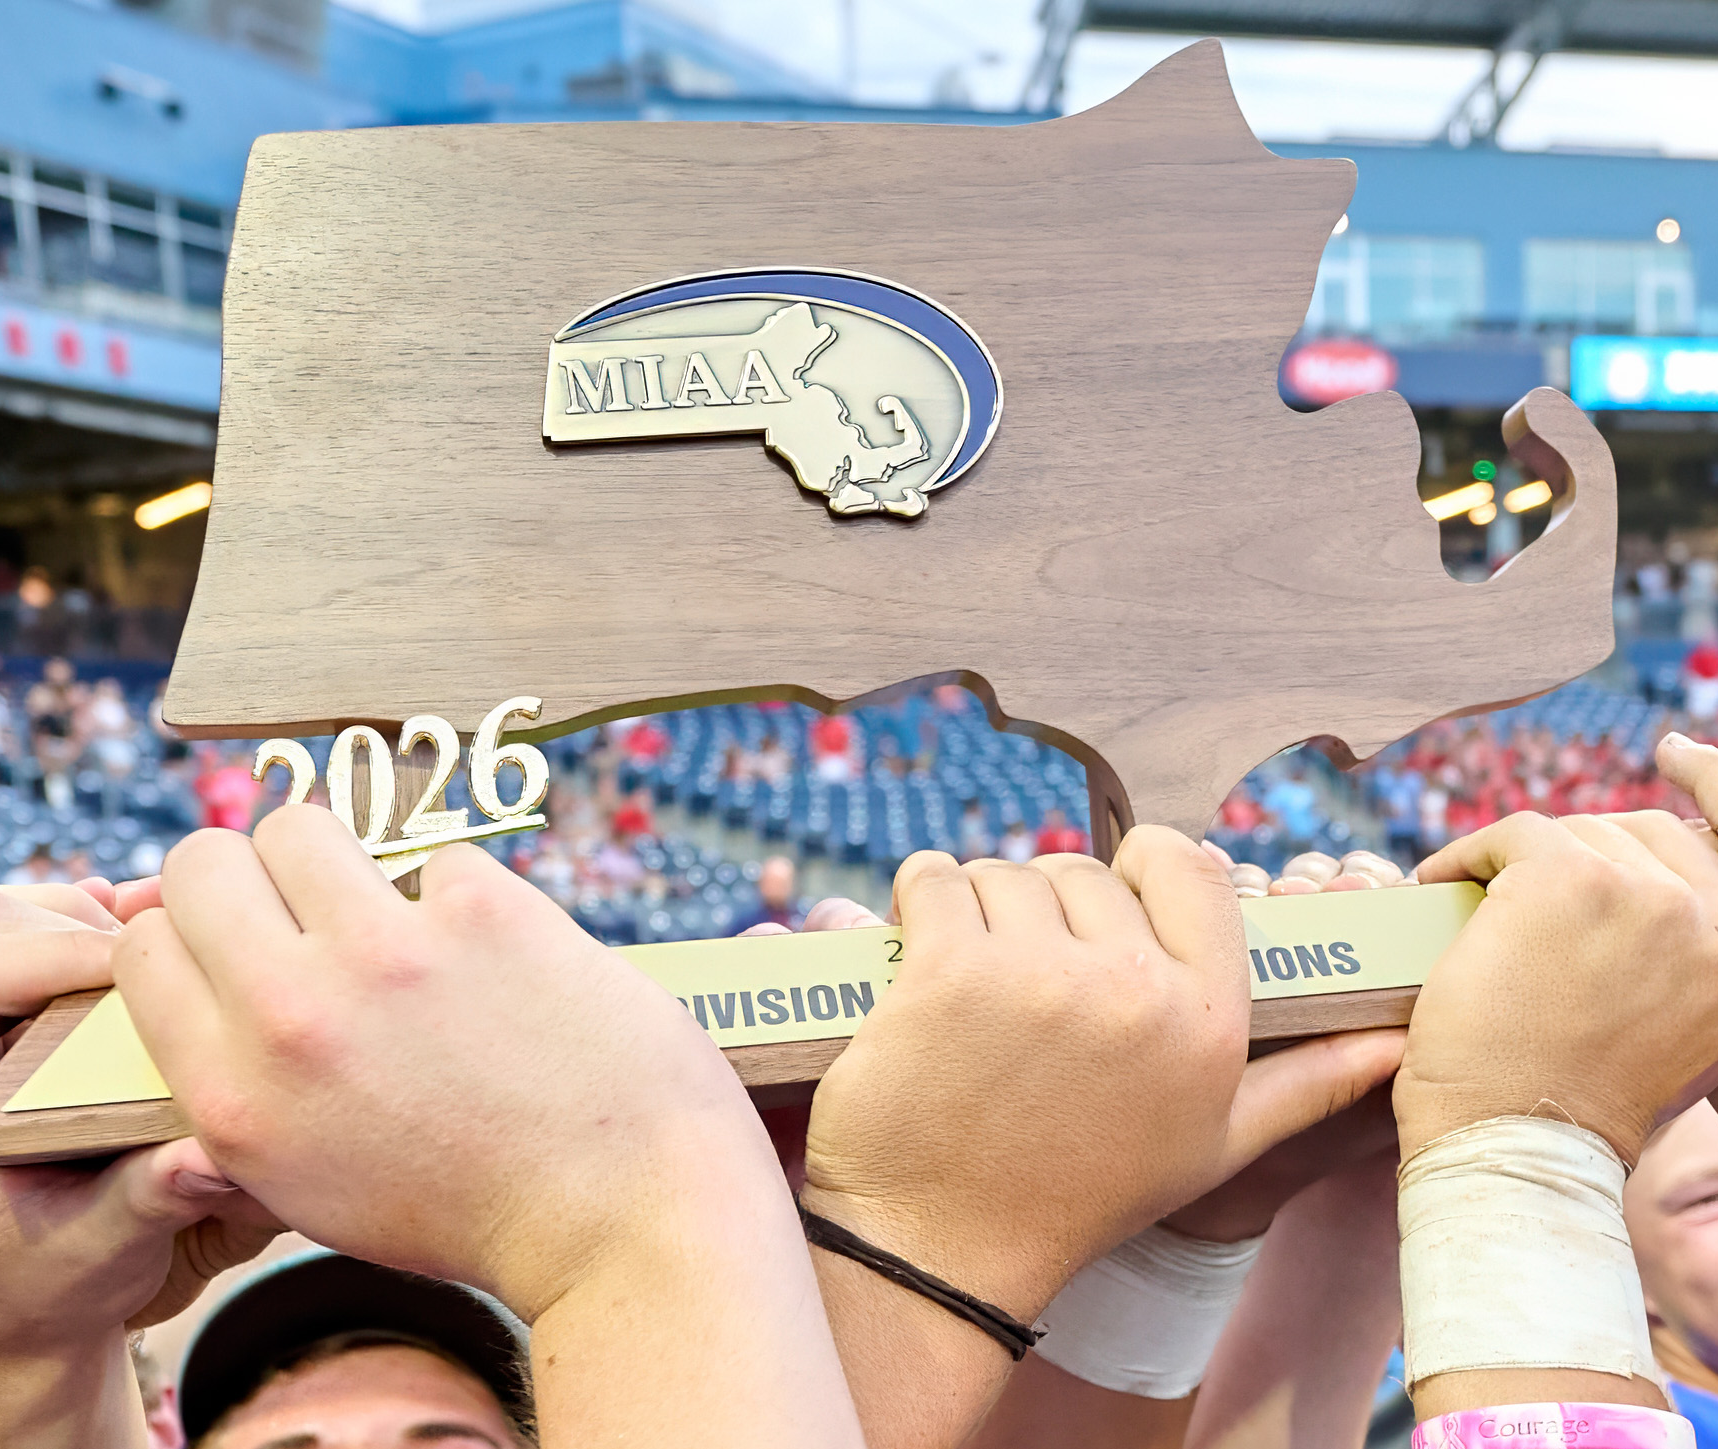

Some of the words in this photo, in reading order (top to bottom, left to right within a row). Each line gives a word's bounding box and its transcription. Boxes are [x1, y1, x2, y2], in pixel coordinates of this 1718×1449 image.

[558, 349, 791, 415] MIAA
[252, 696, 550, 844] 2026
[1249, 941, 1361, 983] IONS
[1479, 1418, 1590, 1443] Courage
